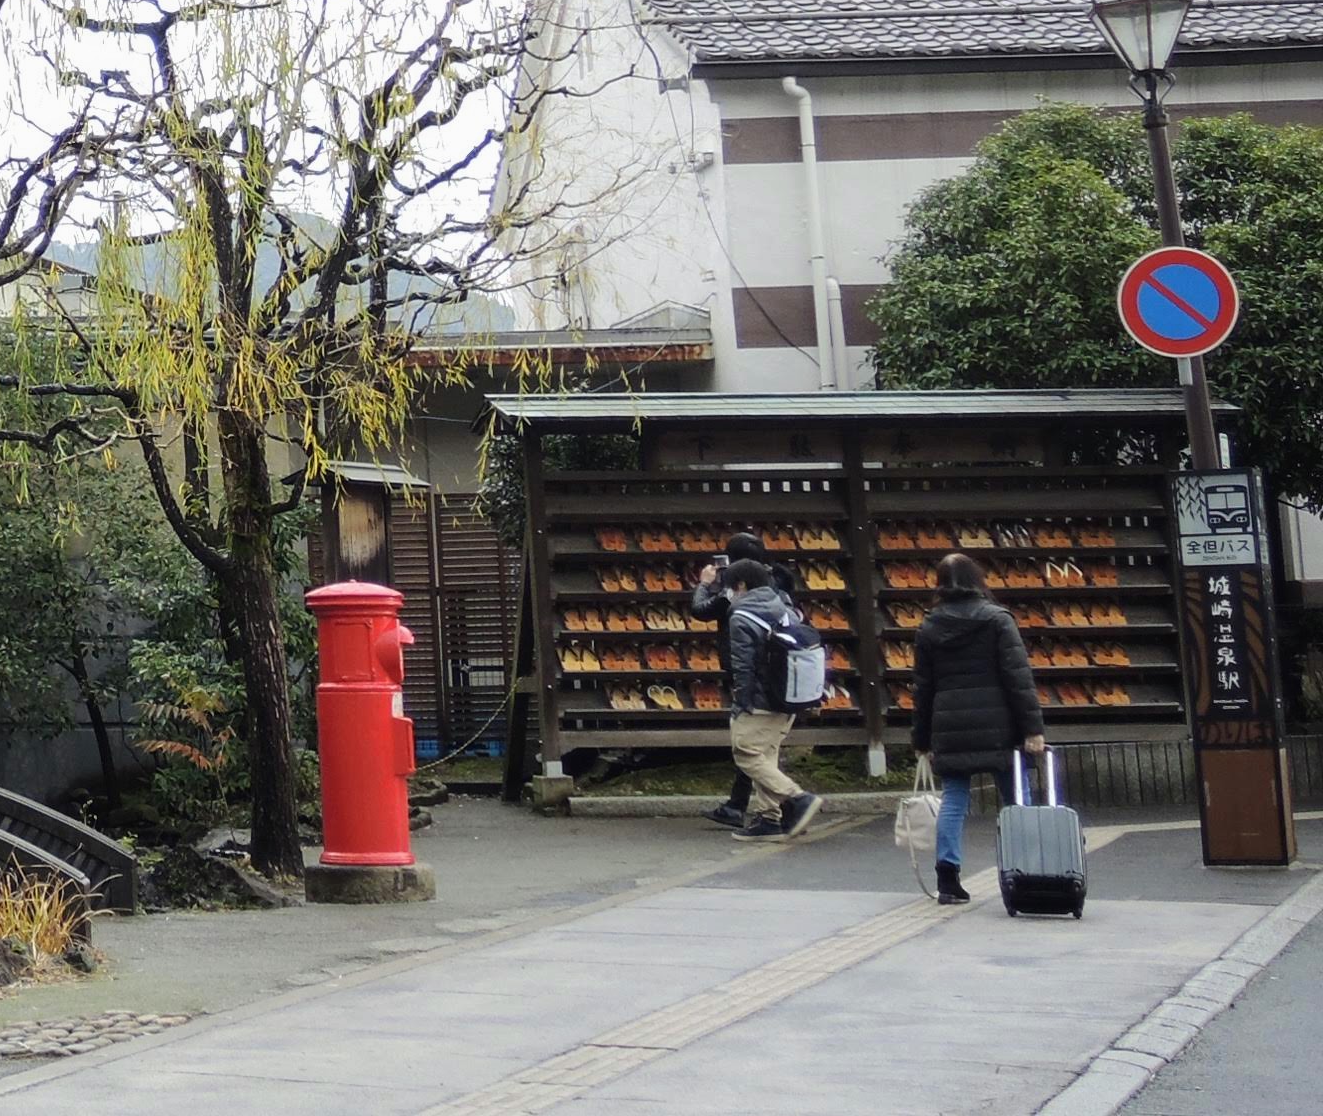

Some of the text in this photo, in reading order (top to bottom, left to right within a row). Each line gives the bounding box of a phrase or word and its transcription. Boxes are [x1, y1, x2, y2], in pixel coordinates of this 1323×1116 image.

[1186, 539, 1251, 555] 全但バス
[1207, 574, 1241, 691] 城崎温泉駅
